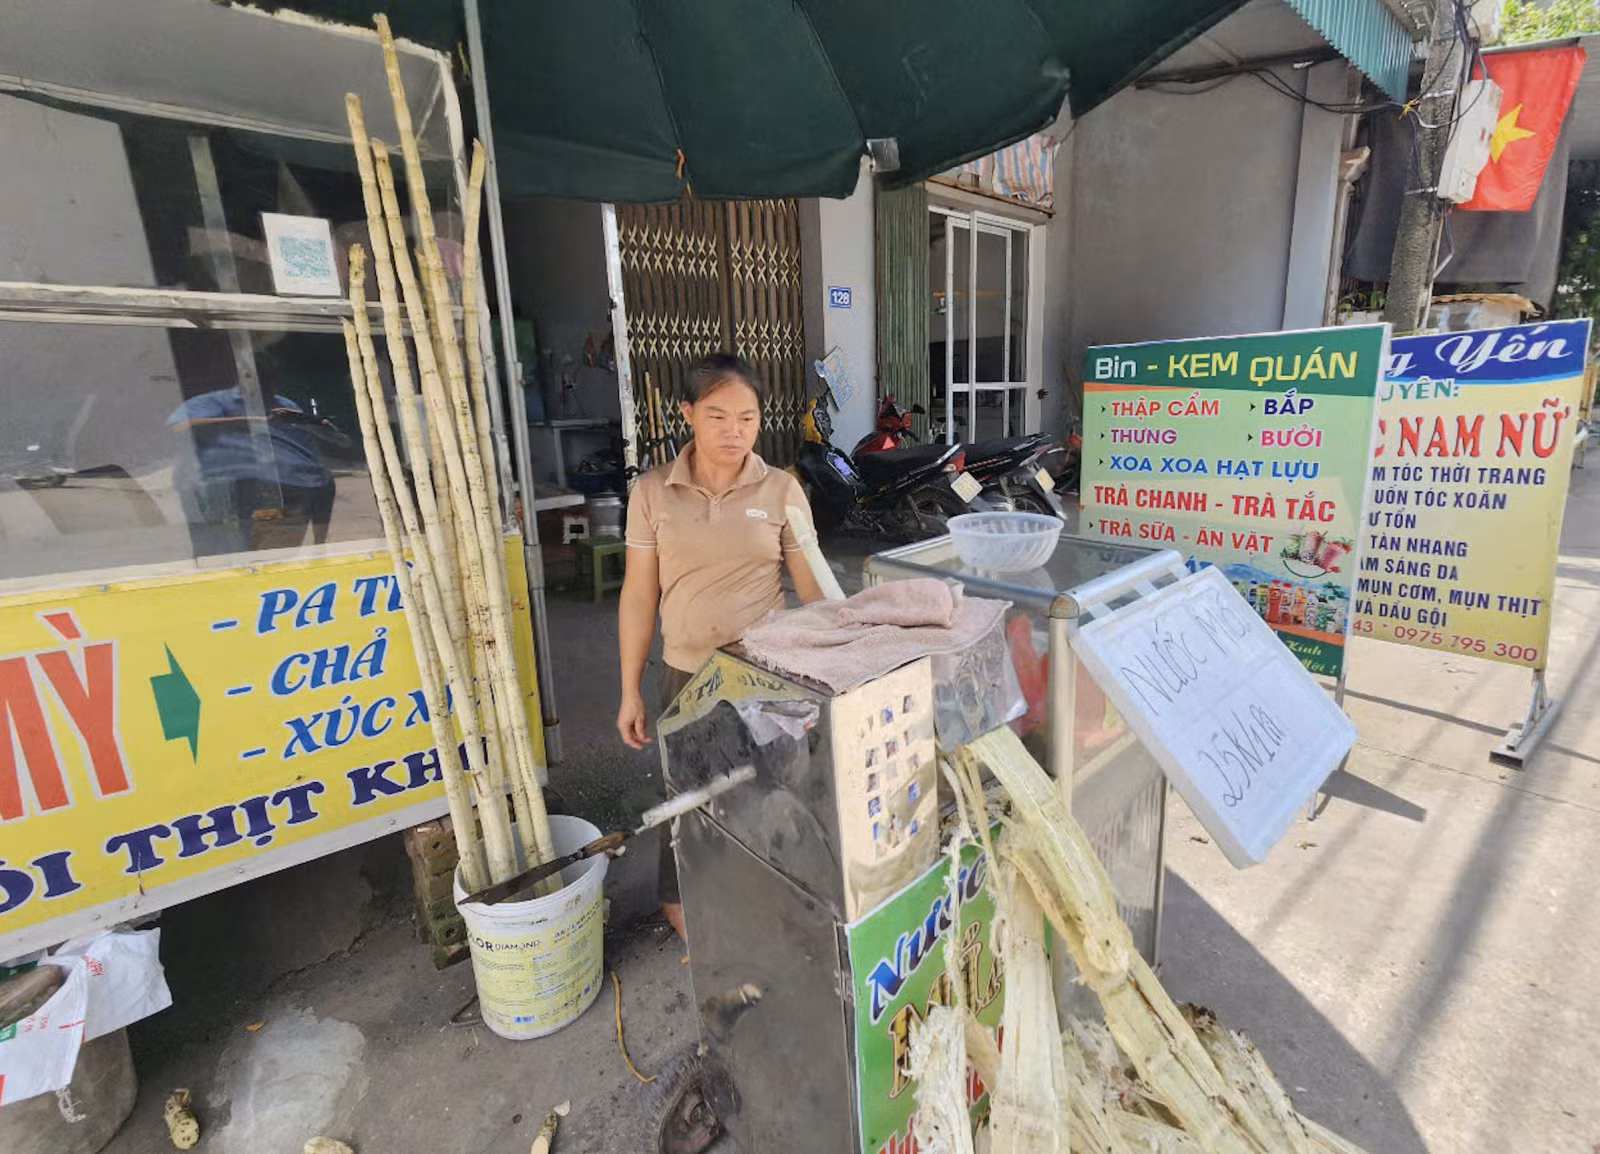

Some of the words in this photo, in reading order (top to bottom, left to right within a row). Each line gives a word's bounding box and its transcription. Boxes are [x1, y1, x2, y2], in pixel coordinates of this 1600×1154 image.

[832, 291, 850, 304] 128
[1096, 355, 1136, 379] Bin
[1168, 351, 1238, 378] KEM
[1250, 346, 1357, 387] QUÁN
[1435, 326, 1572, 373] Yến
[1112, 397, 1162, 420] THẬP
[1168, 391, 1220, 416] CẨM
[1264, 389, 1314, 415] BẮP
[1261, 423, 1322, 447] BƯỞI
[1397, 415, 1485, 457] NAM
[1496, 397, 1571, 458] NỮ
[1110, 456, 1152, 471] XOA
[1160, 458, 1208, 474] XOA
[1217, 459, 1264, 480] HẠT
[1271, 460, 1320, 484] LỰU
[1393, 463, 1423, 482] TÓC
[1431, 463, 1471, 483] THỜI
[1478, 467, 1546, 486] TRANG
[1094, 483, 1129, 507] TRÀ
[1135, 489, 1207, 512] CHANH
[1232, 492, 1276, 519] TRÀ
[1285, 491, 1336, 523] TẮC
[1414, 487, 1448, 507] TÓC
[1453, 491, 1507, 510] XOĂN
[1099, 518, 1132, 538] TRÀ
[1139, 521, 1176, 543] SỮA
[1232, 532, 1275, 555] VẶT
[1371, 532, 1401, 551] TÀN
[1407, 537, 1468, 557] NHANG
[1385, 557, 1431, 578] SÁNG
[1437, 564, 1459, 581] DA
[257, 582, 337, 634] PA
[1355, 598, 1373, 615] VÀ
[1379, 599, 1412, 621] DẦU
[1418, 607, 1447, 629] GỘI
[1357, 578, 1392, 597] MỤN
[1449, 588, 1489, 613] MỤN
[1497, 595, 1542, 618] THỊT
[1353, 620, 1373, 633] 43
[1394, 625, 1442, 645] 0975
[1450, 635, 1486, 653] 795
[1494, 643, 1538, 662] 300
[271, 627, 388, 696] CHẢ
[283, 696, 395, 759] XÚC
[106, 781, 324, 874] THỊT
